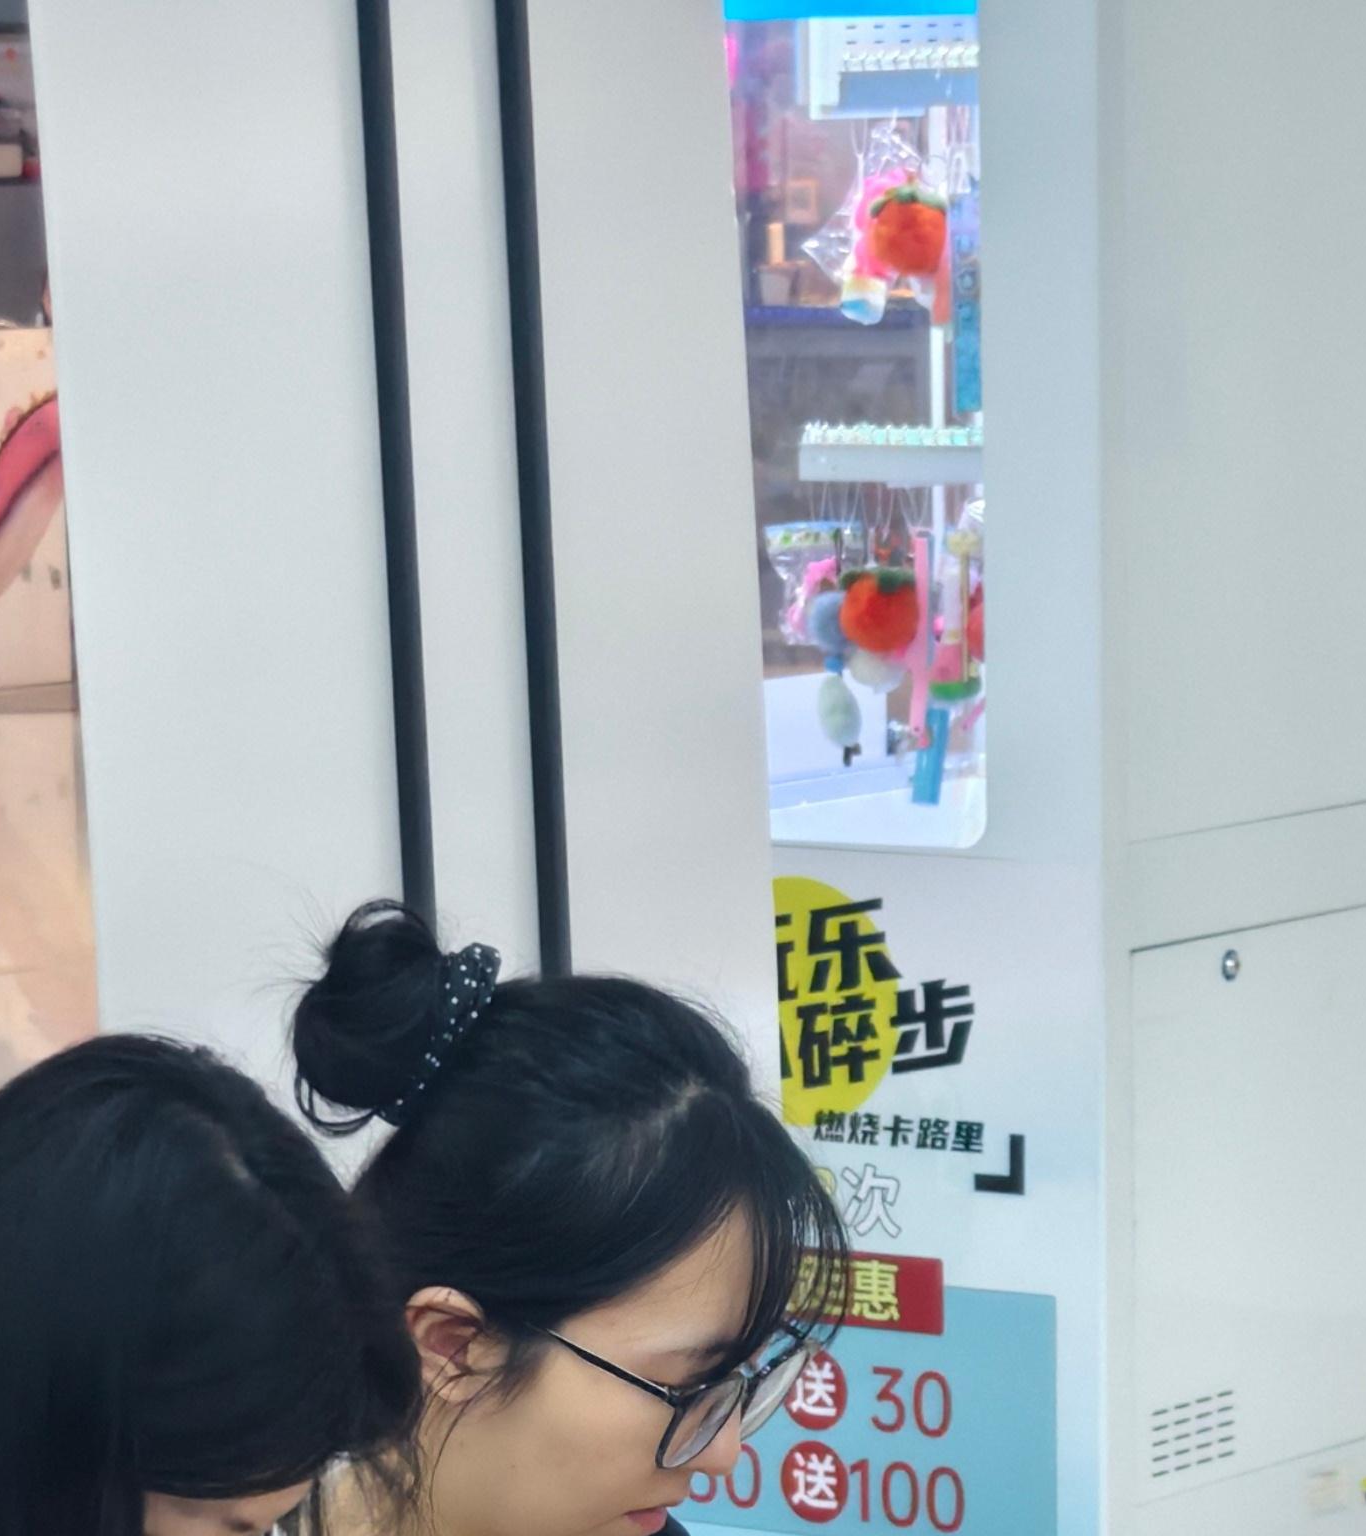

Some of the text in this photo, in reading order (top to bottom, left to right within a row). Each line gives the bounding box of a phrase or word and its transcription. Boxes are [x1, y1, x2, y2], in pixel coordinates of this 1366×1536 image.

[813, 1110, 984, 1154] 燃烧卡路里
[871, 1366, 952, 1438] 30
[849, 1459, 965, 1534] 100
